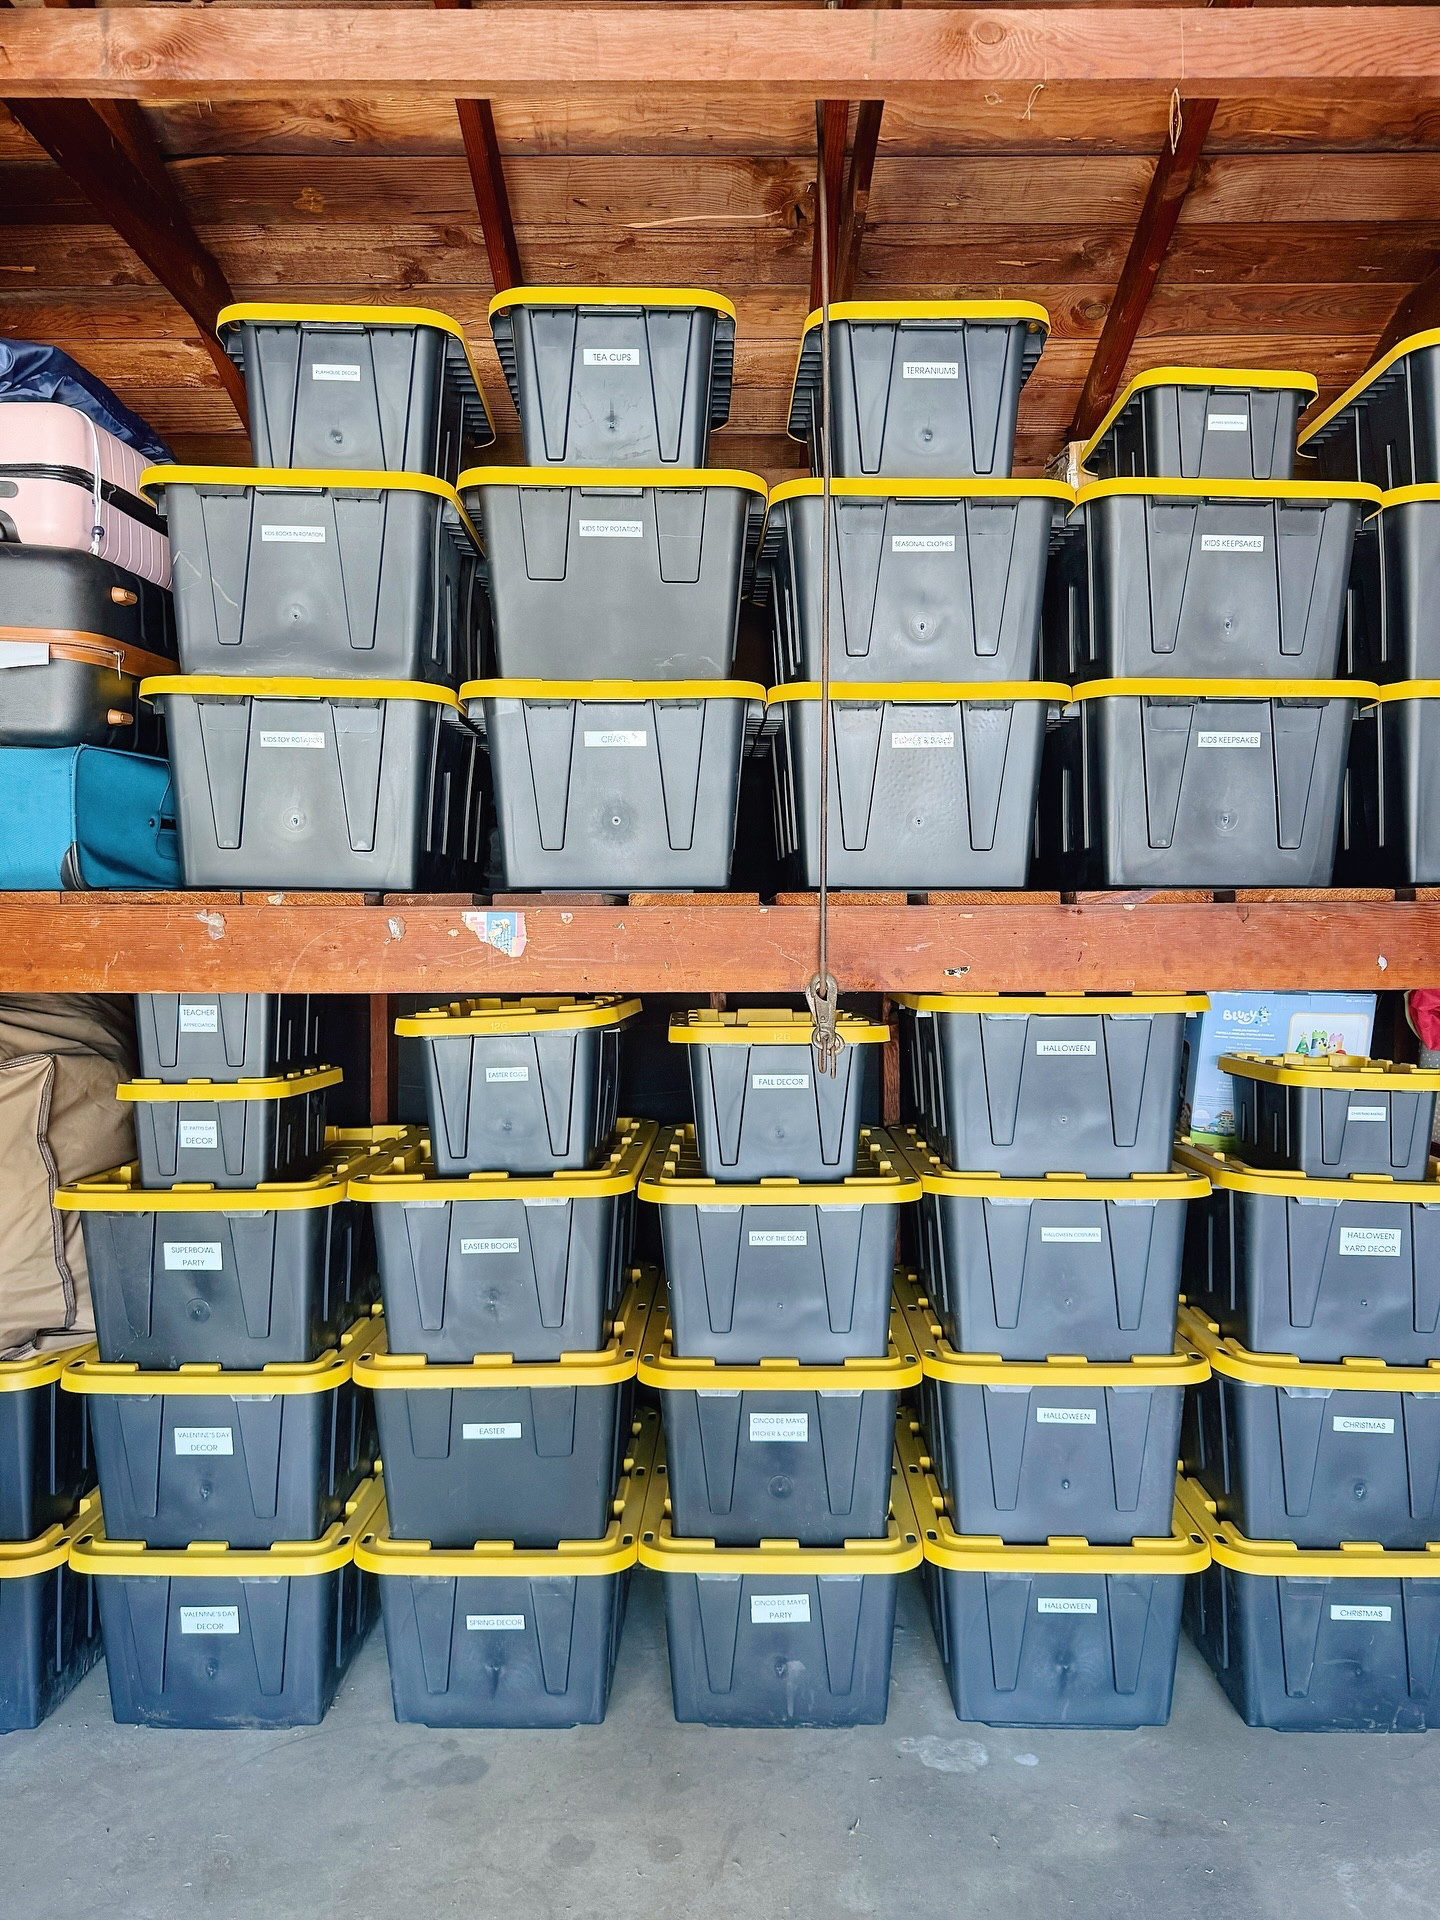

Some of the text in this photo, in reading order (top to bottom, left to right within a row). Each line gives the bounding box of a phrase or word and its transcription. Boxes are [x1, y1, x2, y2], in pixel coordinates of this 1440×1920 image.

[592, 353, 632, 362] TEA CUPS
[906, 366, 957, 376] TERRANIUMS
[581, 525, 596, 533] KIDS
[597, 525, 609, 533] TOY
[298, 531, 324, 539] ROTATION
[894, 540, 954, 548] SEASONAL CLOTHES
[1203, 539, 1262, 548] KIDS KEEPSAKES
[1200, 735, 1259, 745] KIDS KEEPSAKES
[183, 1008, 215, 1017] TEACHER
[1042, 1043, 1091, 1053] HALLOWEEN
[488, 1071, 508, 1079] EASTER
[758, 1078, 804, 1086] FALL DECOR
[185, 1137, 213, 1145] DECOR
[1347, 1231, 1395, 1241] HALLOWEEN
[463, 1241, 518, 1251] EASTER BOOKS
[1344, 1244, 1397, 1253] YARD DECOR
[170, 1246, 216, 1256] SUPERBOWL
[182, 1259, 206, 1267] PARTY
[1043, 1411, 1091, 1421] HALLOWEEN
[752, 1417, 806, 1425] CINCO DE MAYO
[1342, 1420, 1387, 1430] CHRISTMAS
[177, 1431, 230, 1440] VALENTINE'S DAY
[478, 1427, 506, 1436] EASTER
[782, 1430, 796, 1438] CUP
[190, 1443, 219, 1452] DECOR
[753, 1598, 808, 1607] CINCO DE MAYO
[1044, 1602, 1092, 1610] HALLOWEEN
[183, 1610, 236, 1618] VALENTINE'S DAY
[769, 1611, 793, 1620] PARTY
[1339, 1609, 1383, 1618] CHRISTMAS
[196, 1622, 225, 1631] DECOR
[469, 1618, 523, 1627] SPRING DECOR
